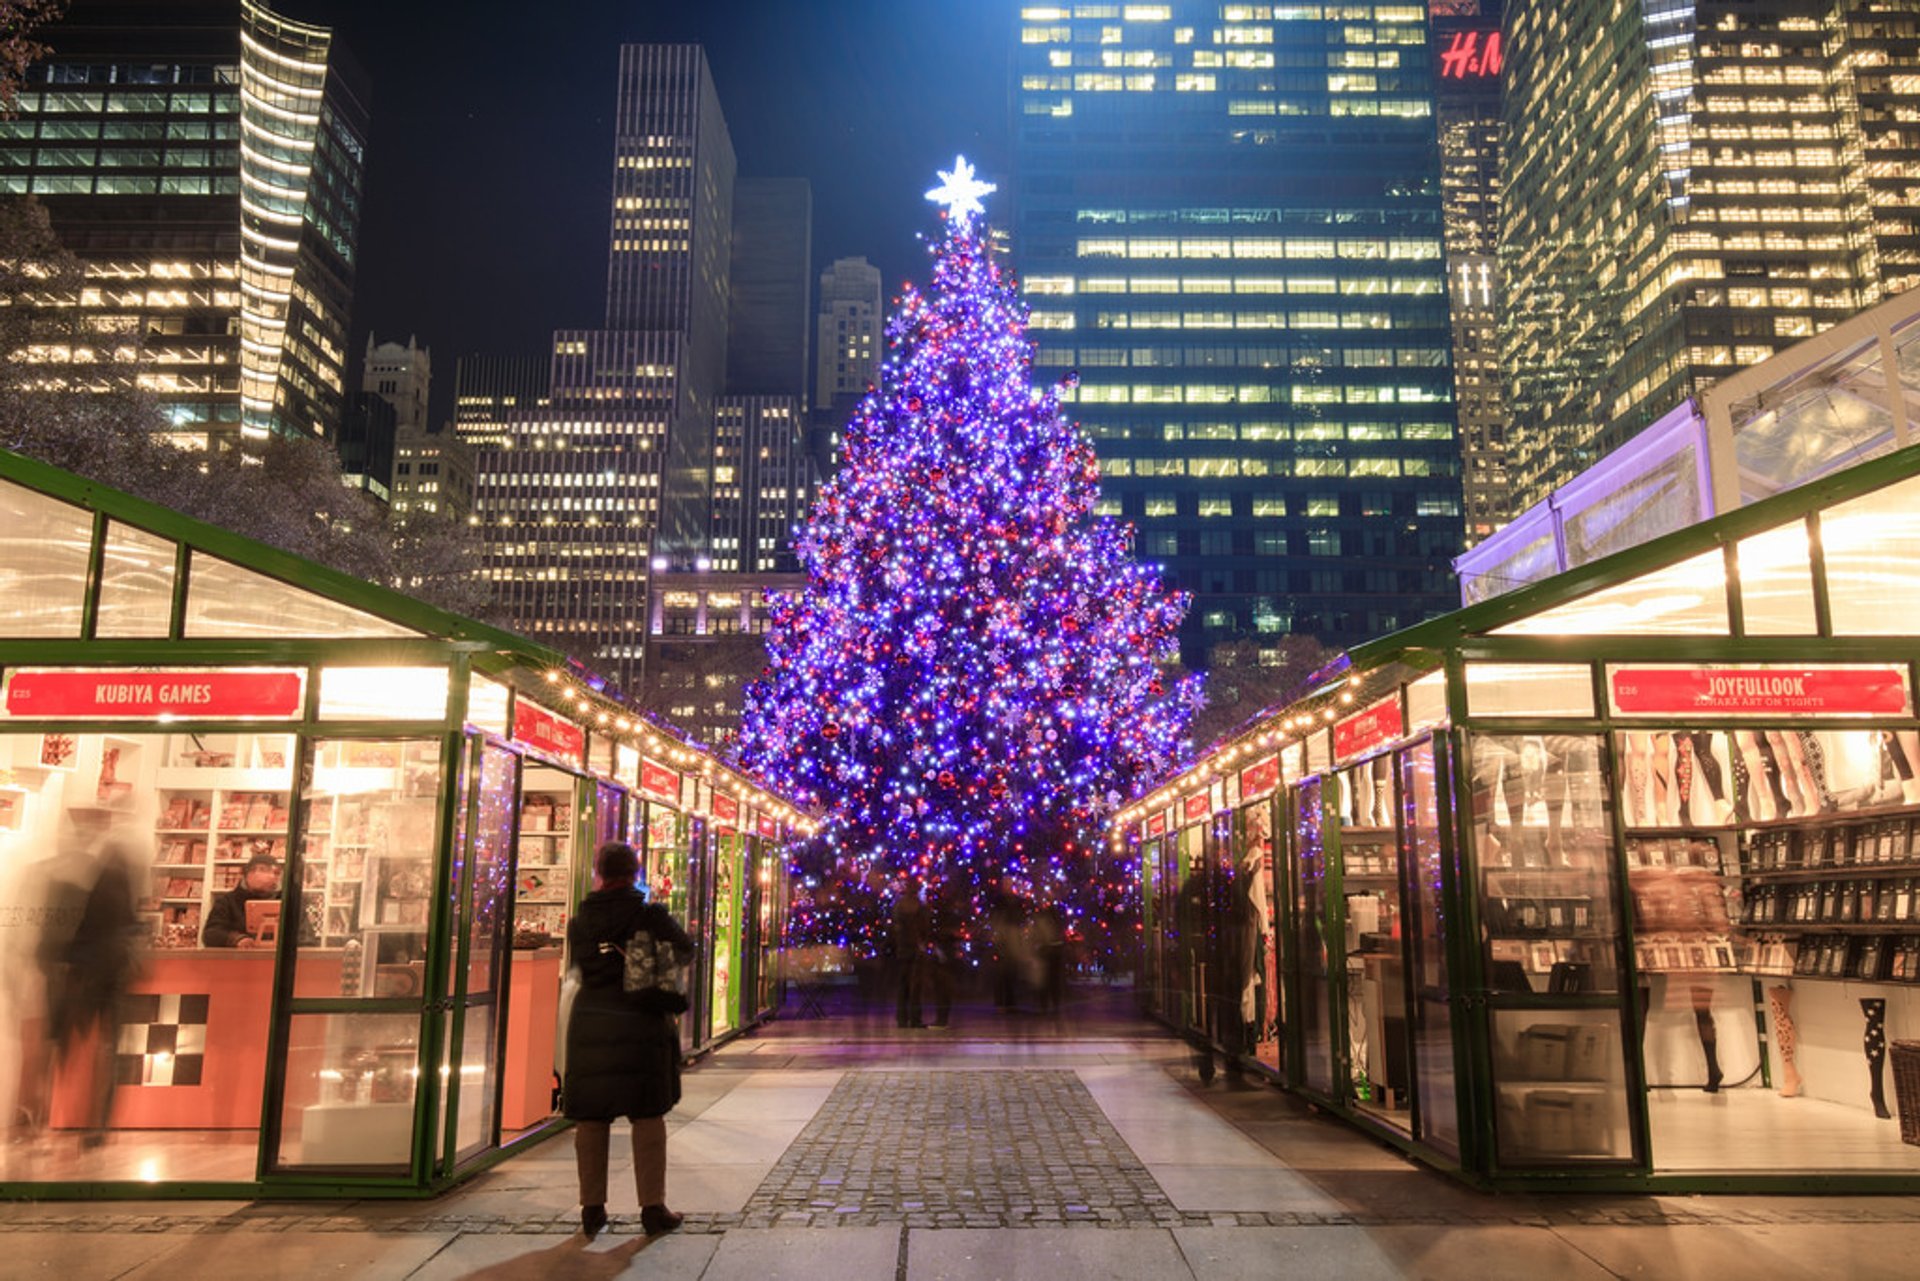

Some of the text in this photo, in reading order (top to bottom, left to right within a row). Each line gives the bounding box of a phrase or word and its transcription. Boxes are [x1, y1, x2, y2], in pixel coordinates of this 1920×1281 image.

[95, 684, 212, 704] KUBIYA GAMES
[1708, 677, 1806, 697] JOYFULLOOK
[1741, 697, 1763, 707] ART
[1764, 697, 1782, 707] ON
[1784, 697, 1825, 707] TIGHTS
